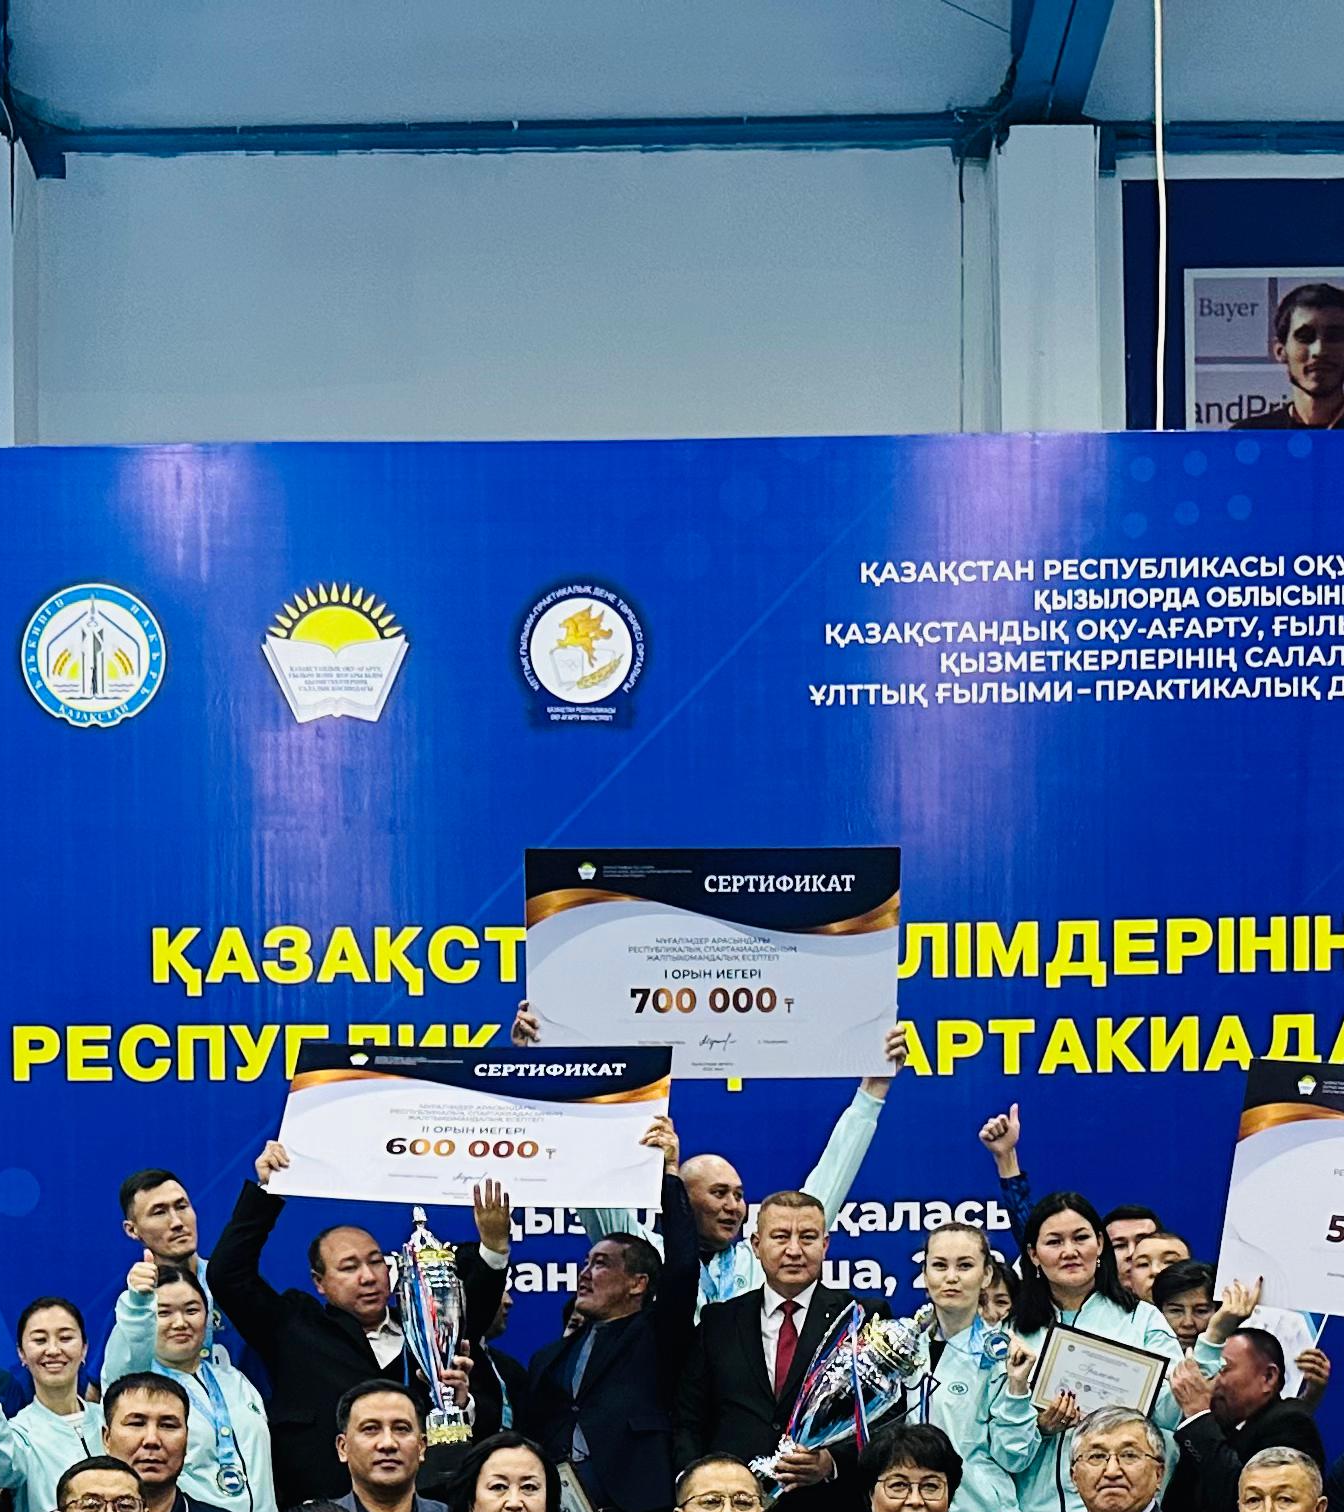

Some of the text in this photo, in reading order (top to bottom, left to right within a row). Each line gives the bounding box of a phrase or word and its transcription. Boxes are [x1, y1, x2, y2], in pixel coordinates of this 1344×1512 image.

[1199, 298, 1259, 323] Bayer
[860, 560, 1034, 587] ҚАЗАҚСТАН
[1044, 556, 1286, 581] РЕСПУБЛИКАСЫ
[1035, 588, 1200, 613] ҚЫЗЫЛОРДА
[825, 620, 1069, 648] ҚАЗАҚСТАНДЫҚ
[1077, 616, 1265, 644] ОҚУ-АҒАРТУ,
[940, 647, 1238, 678] ҚЫЗМЕТКЕРЛЕРІНІҢ
[809, 683, 927, 708] ҰЛТТЫҚ
[704, 874, 855, 893] СЕРТИФИКАТ
[152, 926, 526, 997] ҚАЗАҚСТ
[671, 969, 712, 979] ОРЫН
[716, 969, 761, 979] ИЕГЕРІ
[630, 987, 697, 1014] 700
[708, 987, 777, 1014] 000
[474, 1063, 626, 1077] СЕРТИФИКАТ
[433, 1126, 475, 1134] ОРЫН
[386, 1138, 456, 1157] 600
[468, 1140, 539, 1159] 000
